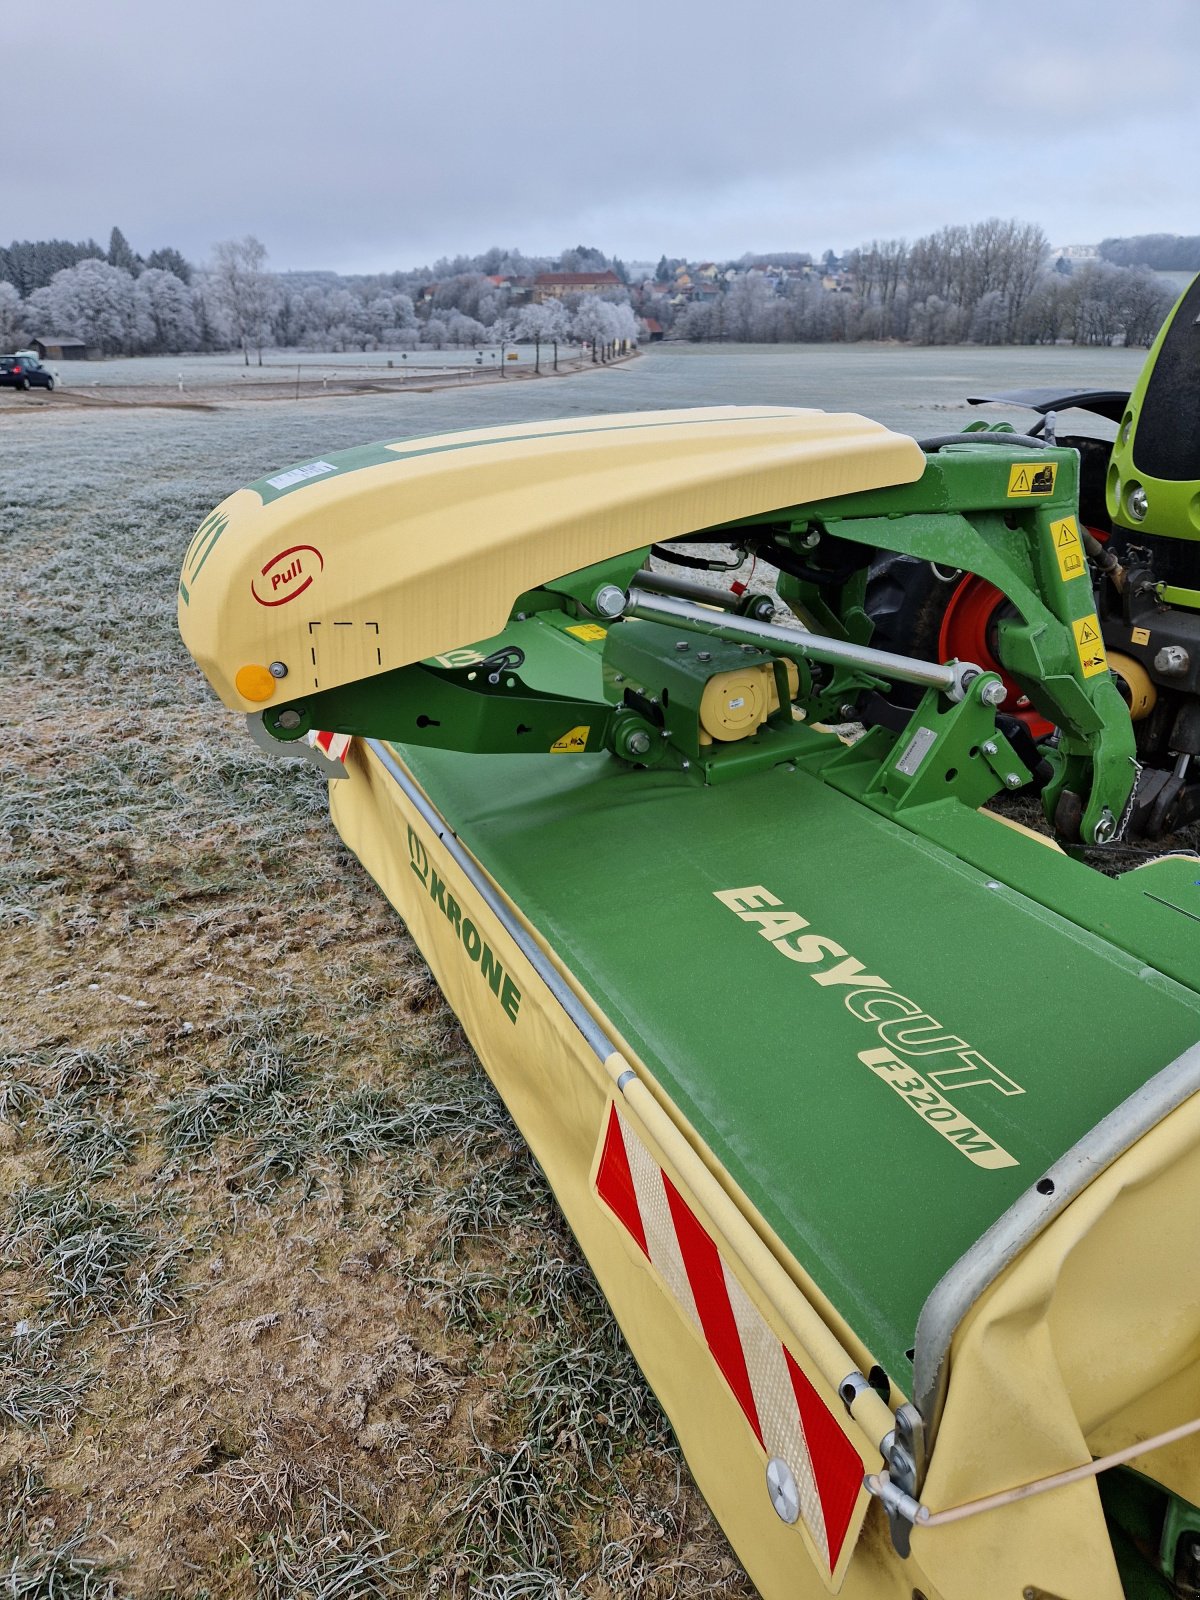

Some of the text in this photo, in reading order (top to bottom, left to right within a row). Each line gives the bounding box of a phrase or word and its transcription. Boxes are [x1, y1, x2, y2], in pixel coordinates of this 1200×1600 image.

[271, 558, 303, 591] Pull
[430, 868, 522, 1026] KRONE
[871, 1060, 997, 1155] F 320 M
